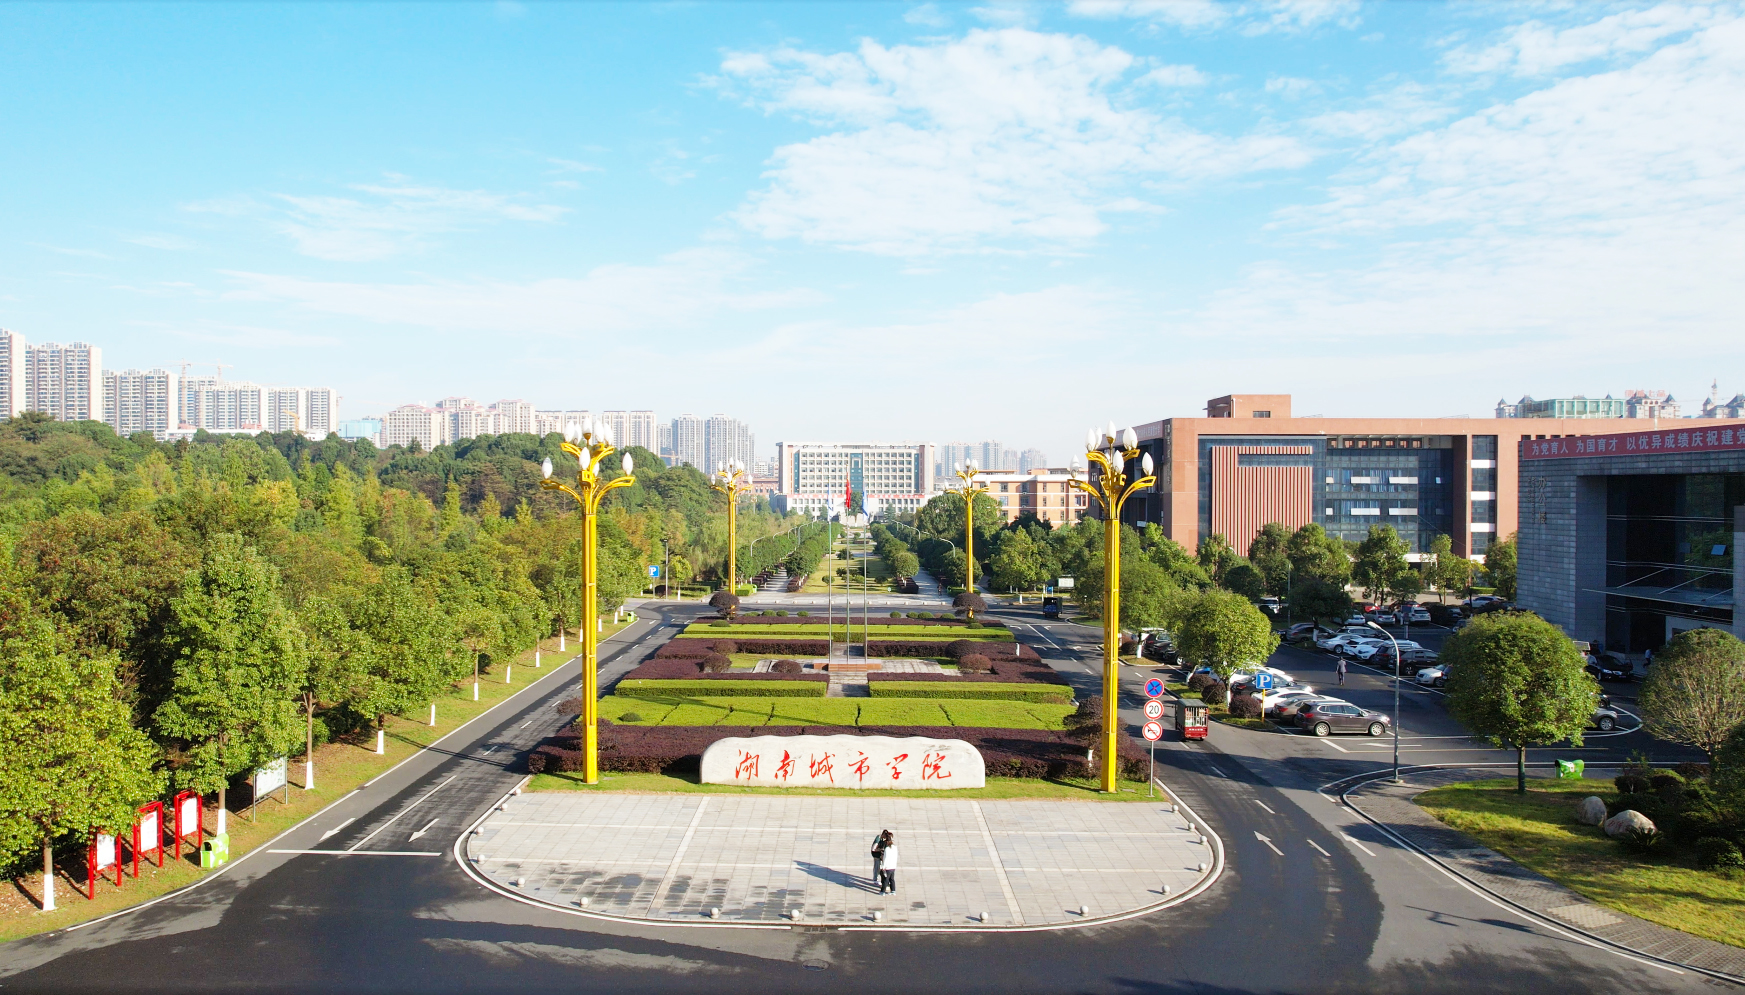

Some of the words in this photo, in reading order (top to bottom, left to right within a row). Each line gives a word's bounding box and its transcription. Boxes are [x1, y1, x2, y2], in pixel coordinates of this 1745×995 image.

[1532, 441, 1569, 456] 为党育人
[1576, 437, 1618, 453] 为国育才
[649, 566, 657, 576] P
[1258, 674, 1271, 688] P
[1148, 704, 1160, 715] 20
[735, 748, 952, 784] 湖南城市学院
